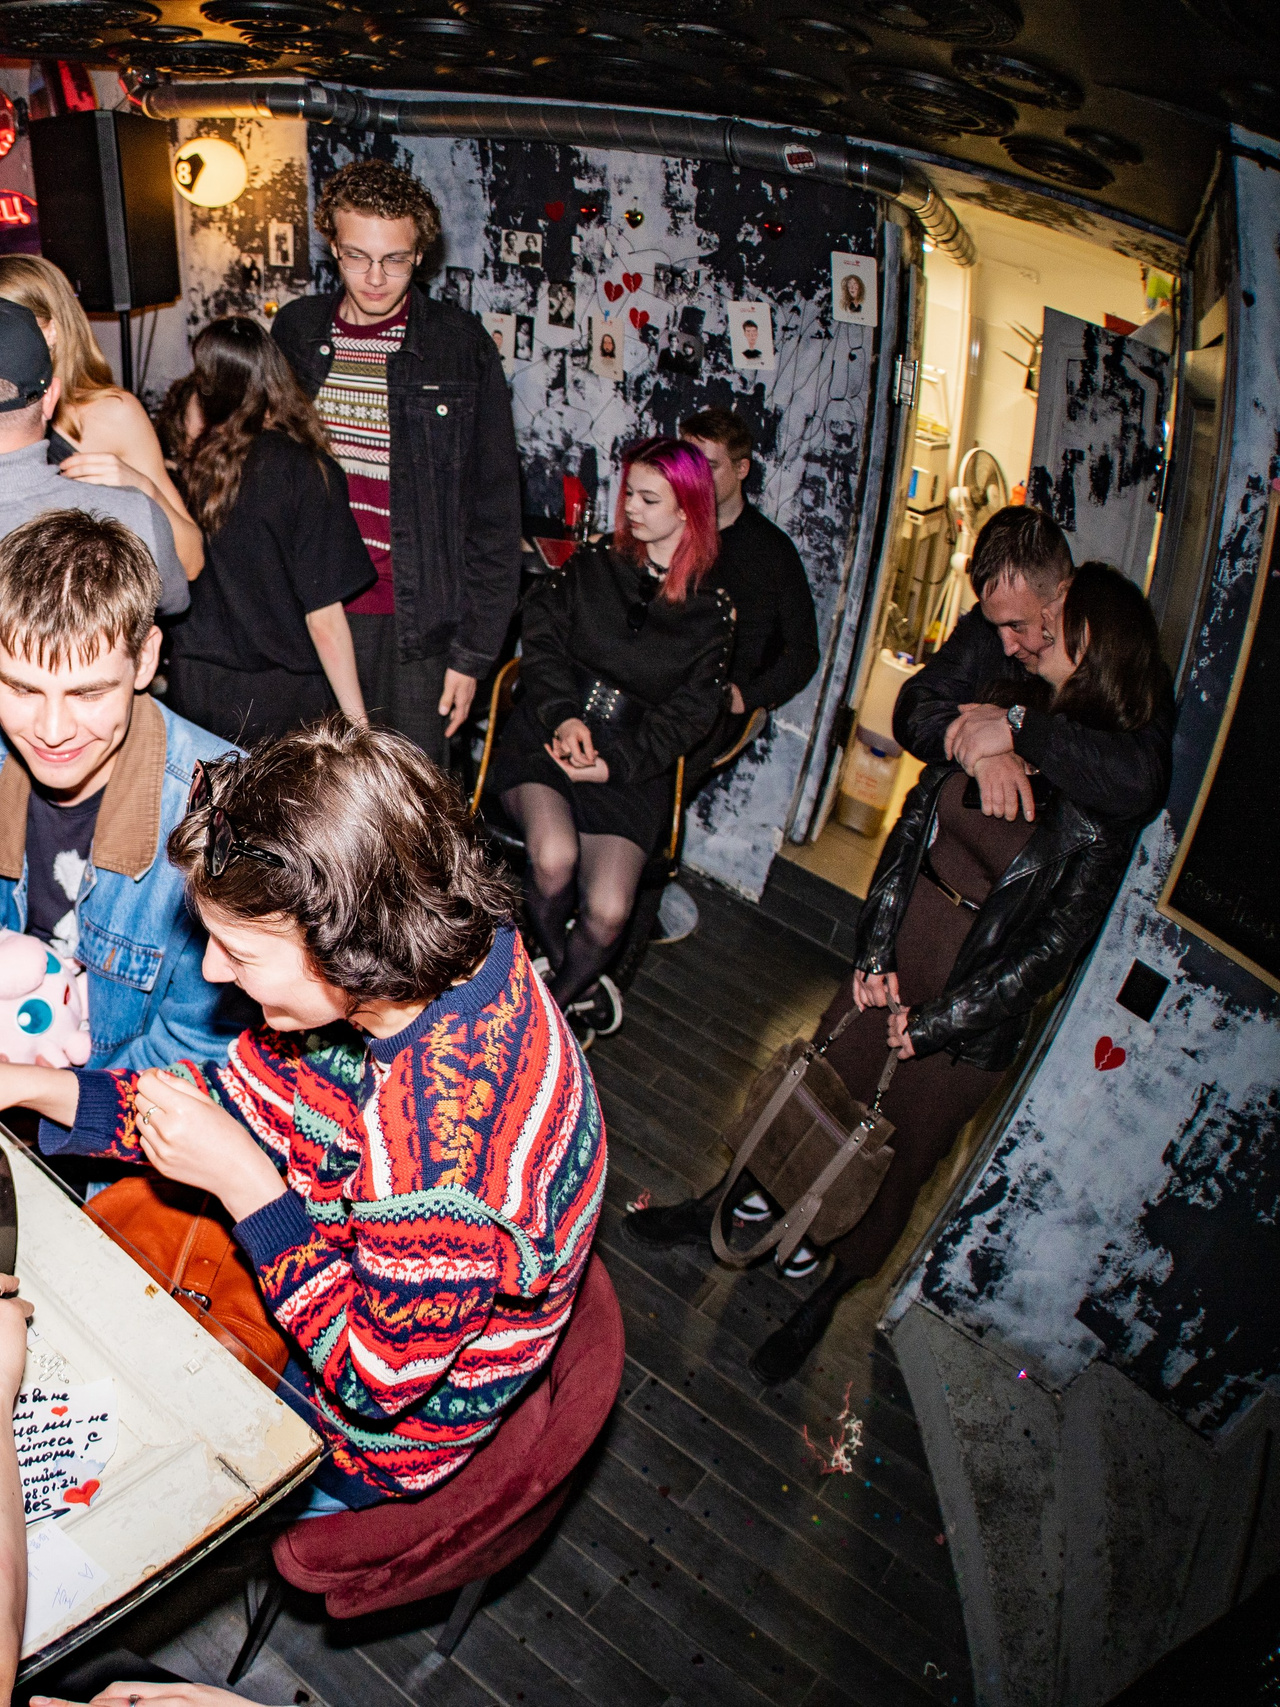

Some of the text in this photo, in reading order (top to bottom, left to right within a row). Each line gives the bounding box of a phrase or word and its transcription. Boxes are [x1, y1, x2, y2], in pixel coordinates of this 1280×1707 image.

[177, 160, 192, 185] 8
[51, 1393, 69, 1402] не
[88, 1413, 108, 1423] не
[25, 1476, 78, 1499] 08.01.24
